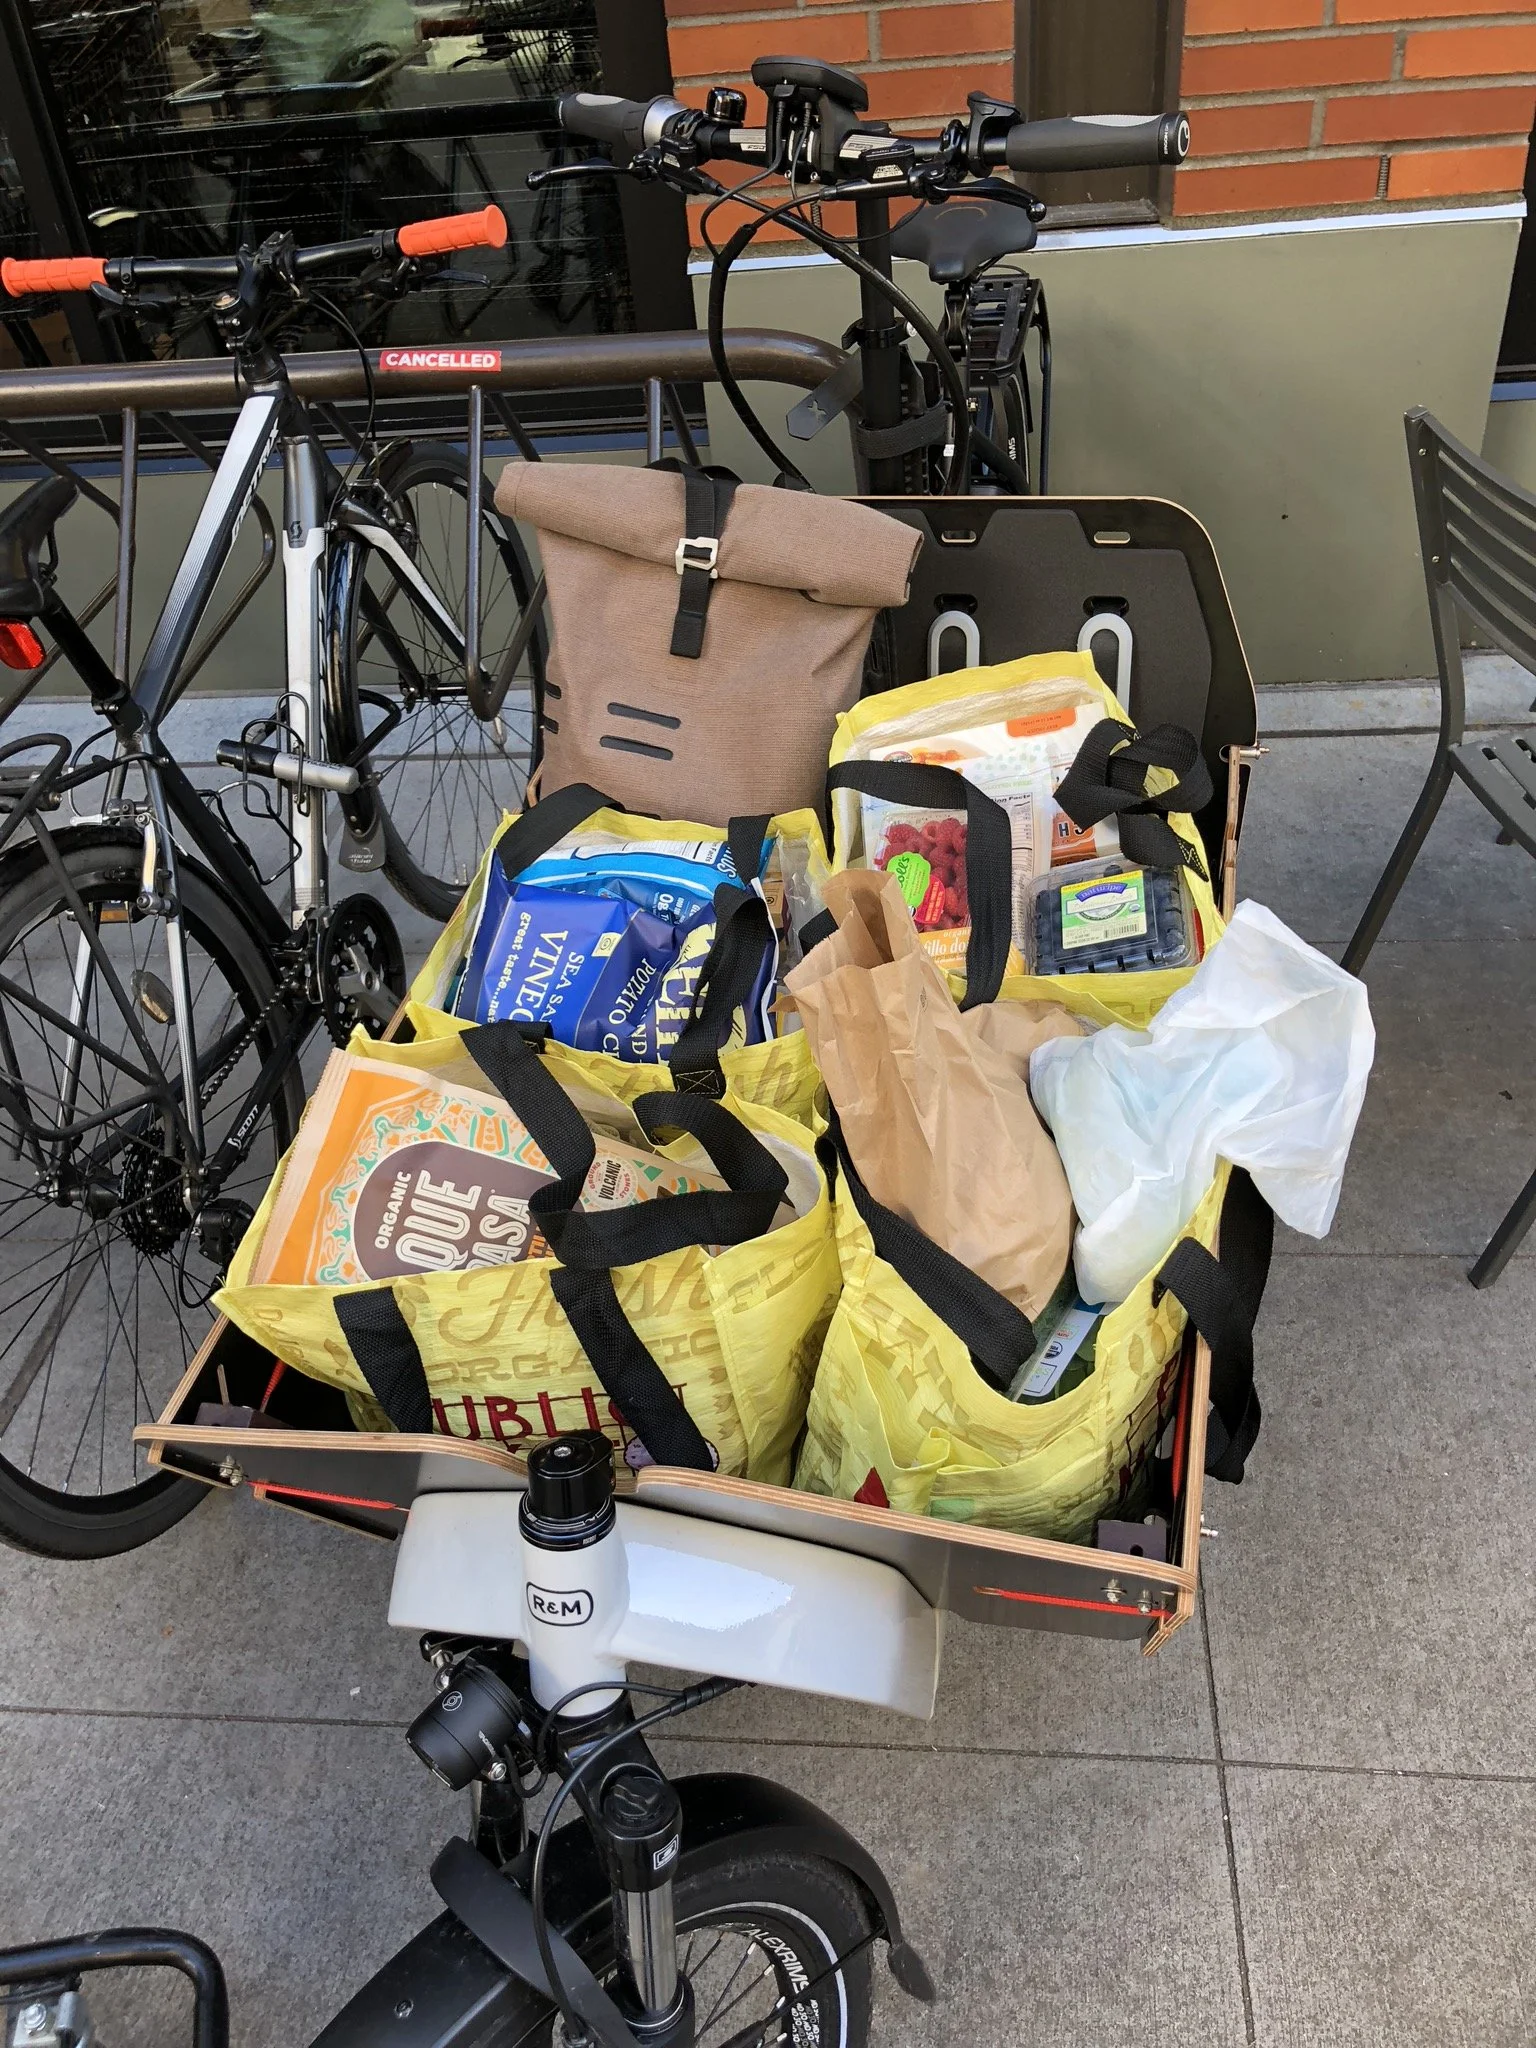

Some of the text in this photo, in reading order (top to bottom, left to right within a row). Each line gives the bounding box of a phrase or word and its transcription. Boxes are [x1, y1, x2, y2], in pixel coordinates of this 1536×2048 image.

[385, 353, 496, 368] CANCELLED
[511, 911, 532, 951] great
[540, 951, 585, 1023] SEA SA
[608, 957, 657, 1025] POTATO
[631, 1024, 648, 1055] ND
[237, 1104, 259, 1140] SCOTT
[588, 1162, 602, 1189] GROUND
[598, 1159, 622, 1201] VOLCANIC
[619, 1173, 631, 1199] STONES
[374, 1171, 412, 1250] ORGANIC
[395, 1169, 483, 1271] QUE
[432, 1386, 632, 1442] UBLI
[532, 1594, 582, 1617] R&M
[739, 1928, 810, 1995] ALEXRIMS
